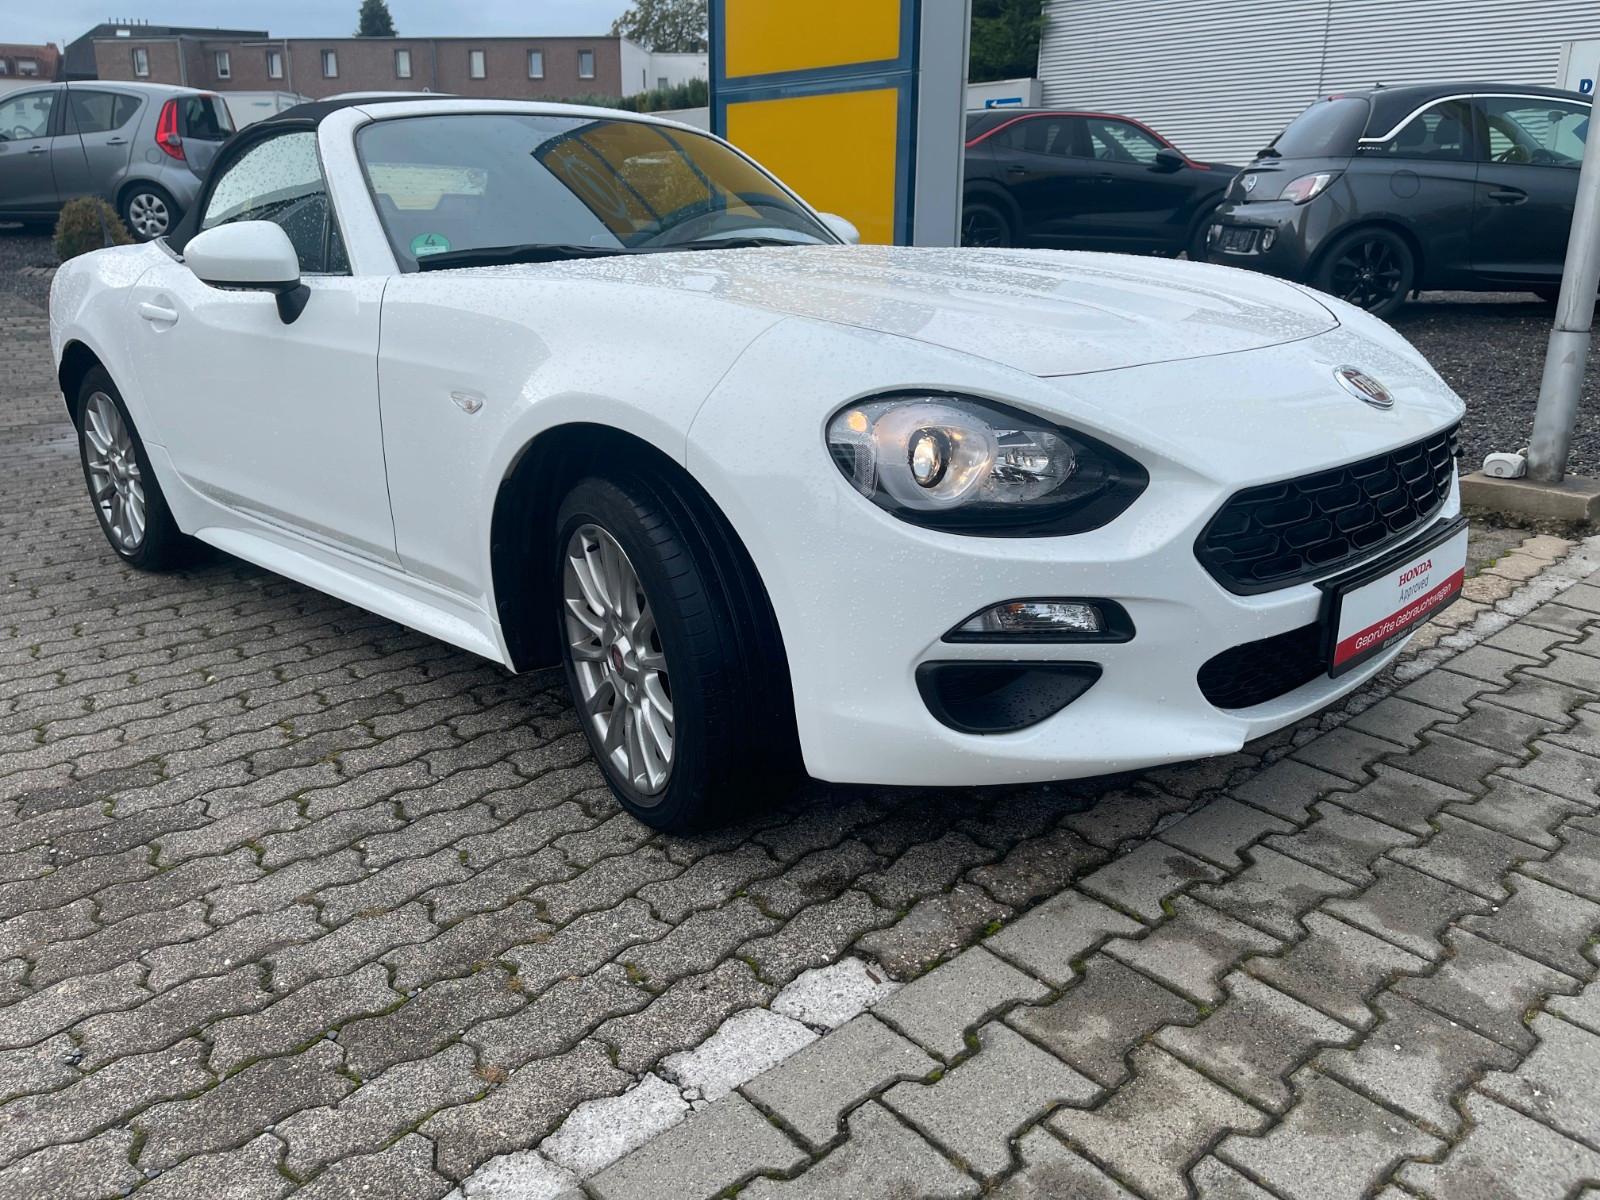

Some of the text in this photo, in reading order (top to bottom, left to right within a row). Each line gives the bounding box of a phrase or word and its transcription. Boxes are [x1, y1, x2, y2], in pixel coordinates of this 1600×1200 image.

[424, 234, 436, 246] 4
[1398, 559, 1433, 588] HONDA
[1398, 573, 1430, 604] Approved
[1355, 621, 1396, 650] Geprüfte
[1395, 582, 1452, 627] Gebrauchtwagen
